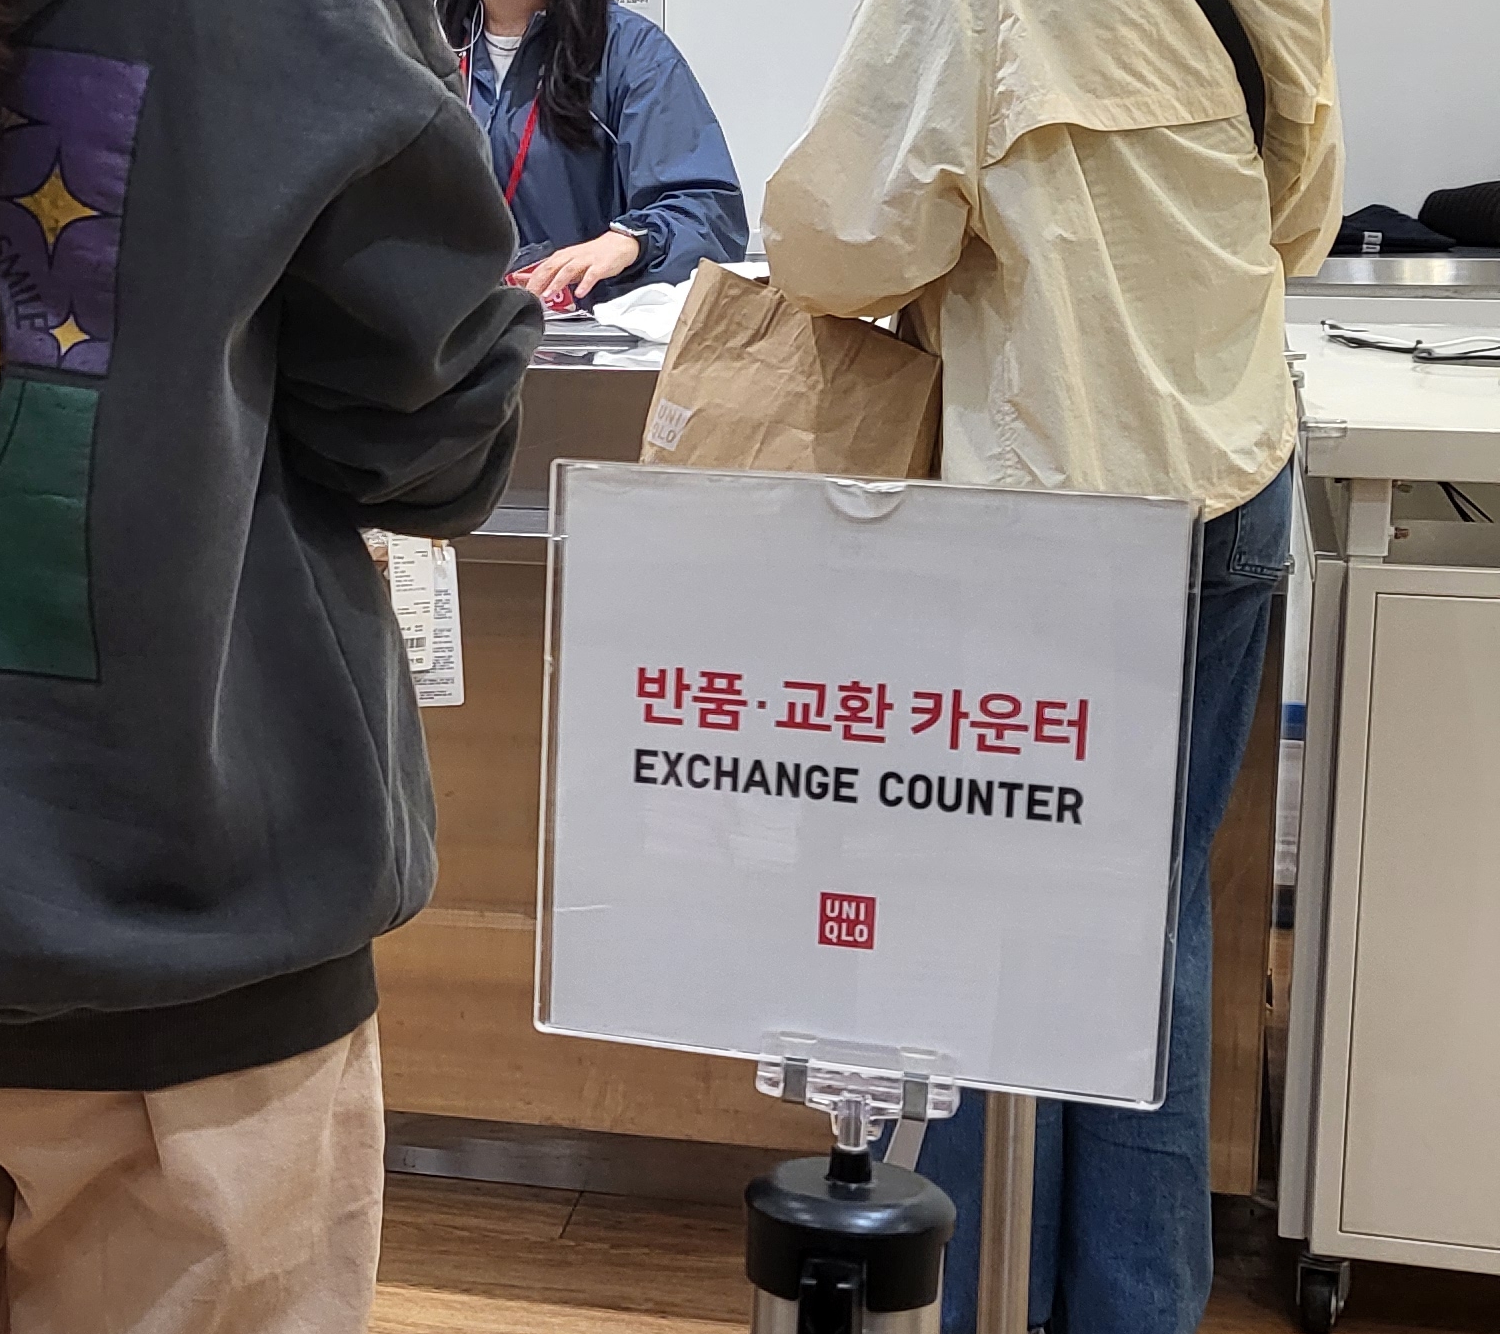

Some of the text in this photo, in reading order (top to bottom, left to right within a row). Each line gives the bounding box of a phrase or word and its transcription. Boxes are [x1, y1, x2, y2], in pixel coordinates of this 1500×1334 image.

[635, 666, 1090, 762] 반품·교환 카운터
[632, 747, 1085, 825] EXCHANGE COUNTER
[824, 920, 869, 944] QLO
[825, 898, 867, 922] UNI
